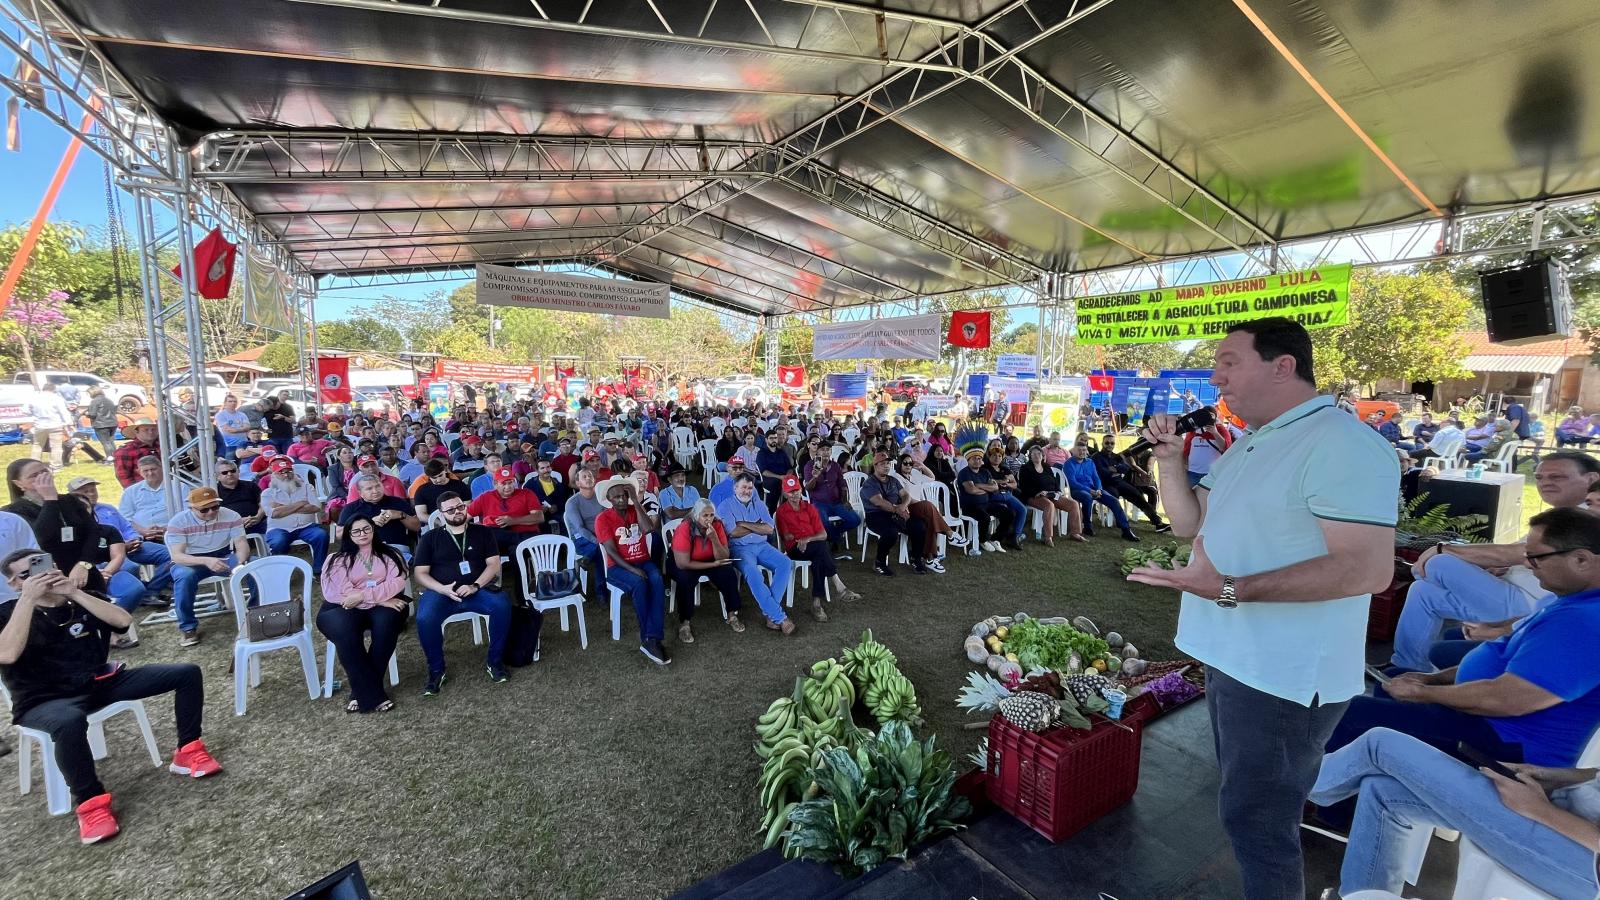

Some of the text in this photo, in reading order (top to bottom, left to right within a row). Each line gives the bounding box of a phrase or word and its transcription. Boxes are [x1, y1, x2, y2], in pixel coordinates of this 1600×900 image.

[483, 281, 538, 294] COMPROMISSO
[579, 291, 629, 303] COMPROMISSO
[533, 278, 589, 291] EQUIPAMENTOS
[590, 283, 607, 292] PARA
[1077, 270, 1322, 310] AGRADECEMOS AO MAPA GOVERNO LULA
[511, 294, 550, 304] OBRIGADO
[552, 298, 586, 307] MINISTRO
[587, 301, 614, 310] CARLOS
[1077, 289, 1338, 325] POR FORTALECER A AGRICULTURA CAMPONESA
[1078, 328, 1103, 339] VIVA
[1105, 328, 1112, 338] O
[1151, 325, 1181, 337] VIVA
[1187, 324, 1196, 335] A
